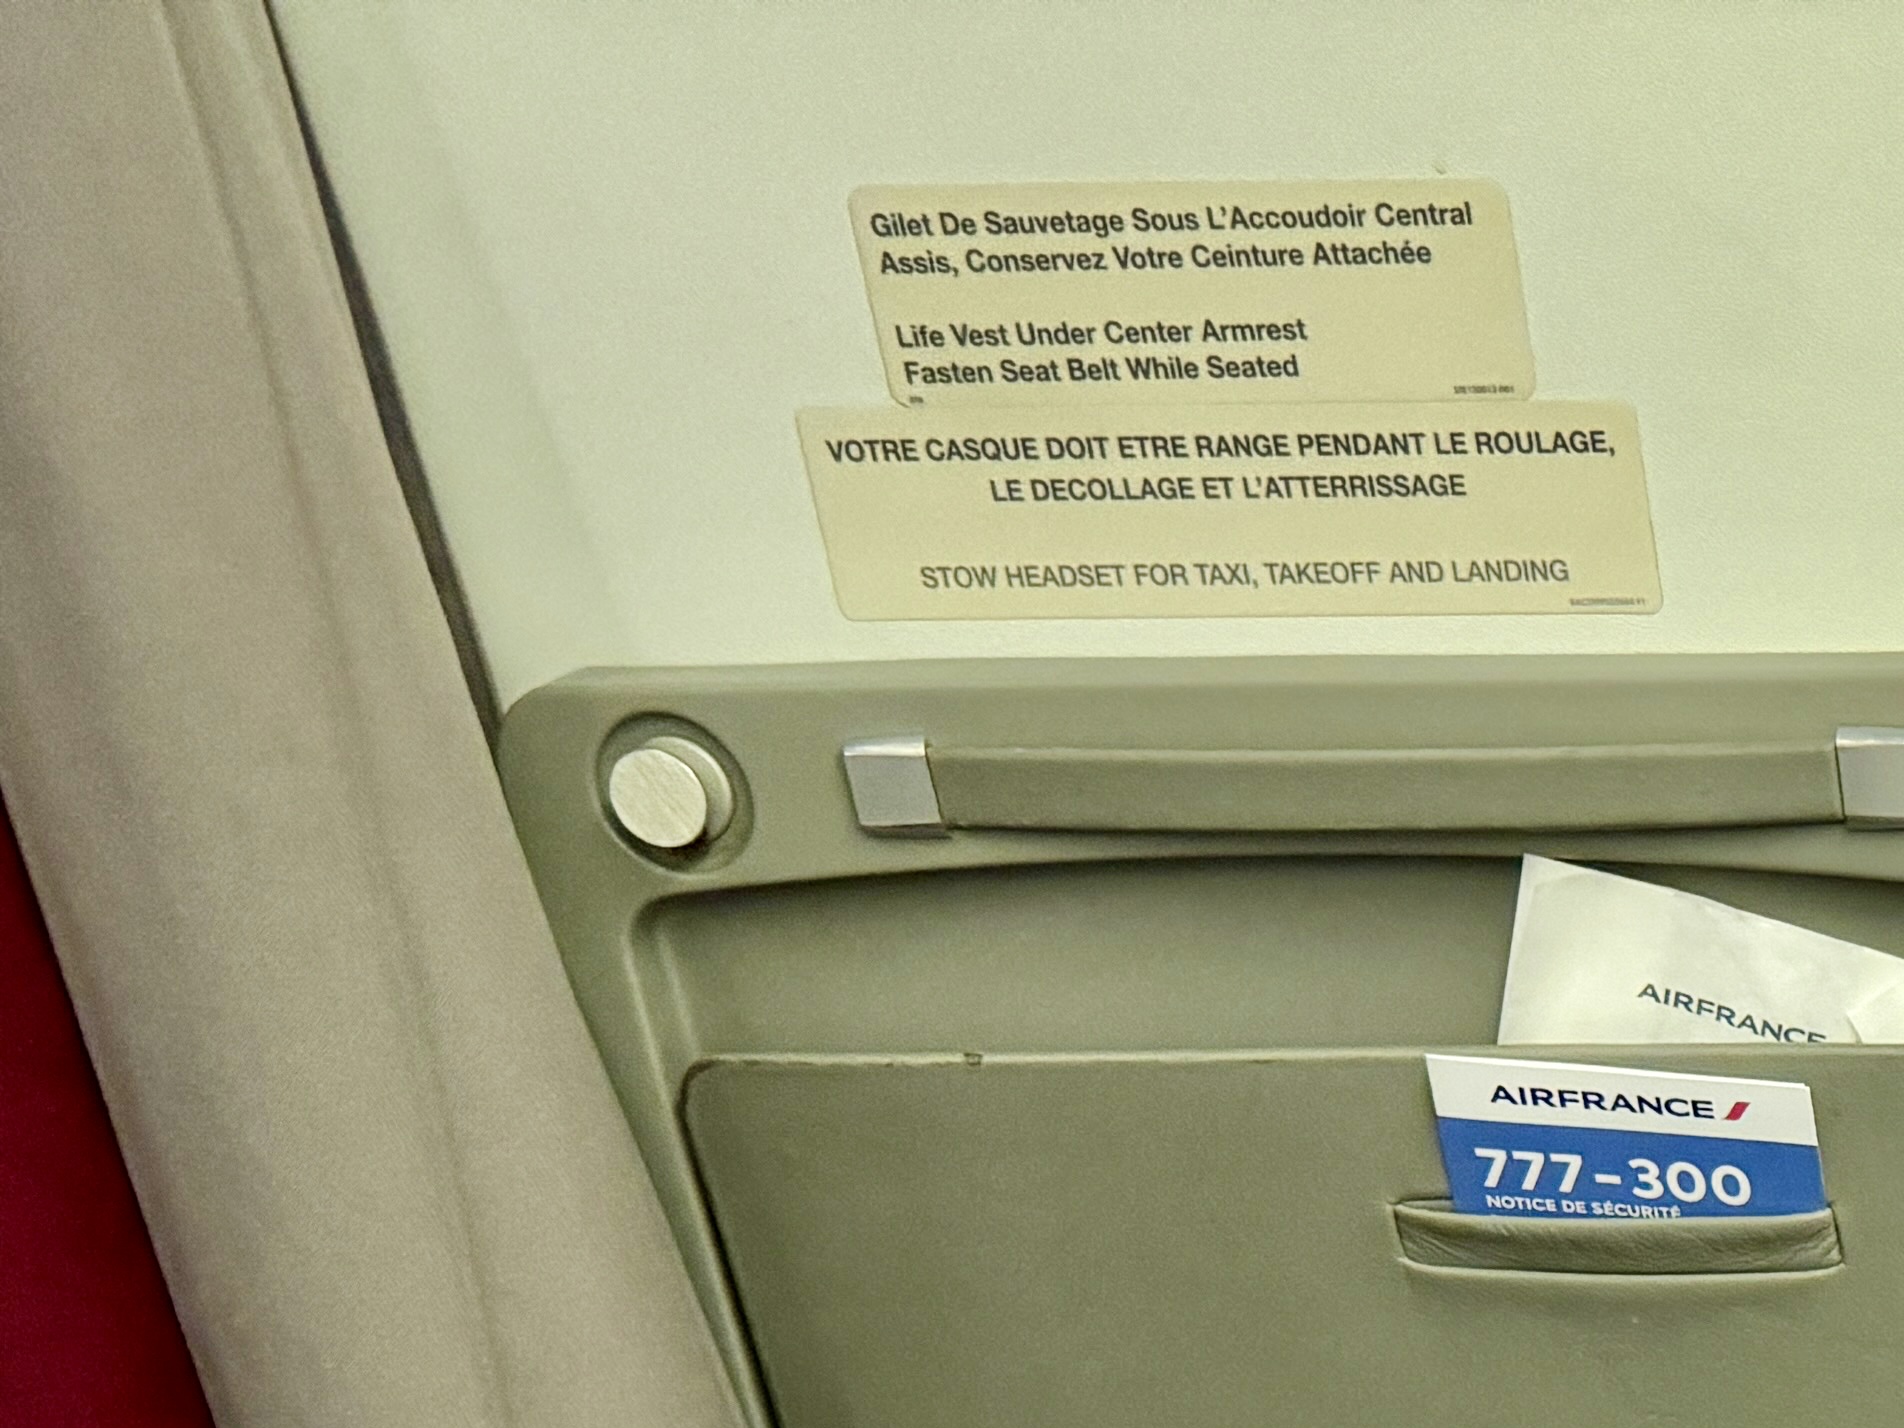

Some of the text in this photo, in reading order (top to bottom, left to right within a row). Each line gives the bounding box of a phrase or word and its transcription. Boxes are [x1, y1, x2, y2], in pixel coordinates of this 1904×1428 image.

[869, 200, 1473, 239] Gilet De Sauvetage Sous L'Accoudoir Central
[880, 239, 1432, 278] Assis, Conservez Votre Ceinture Attachée
[894, 318, 1308, 349] Life Vest Under Center Armrest
[903, 353, 1300, 386] Fasten Seat Belt While Seated
[824, 430, 1616, 463] VOTRE CASQUE DOIT ETRE RANGE PENDANT LE ROULAGE,
[989, 473, 1468, 503] LE DECOLLAGE ET L'ATTERRISSAGE
[919, 559, 1570, 590] STOW HEADSET FOR TAXI, TAKEOFF AND LANDING
[1636, 982, 1828, 1043] AIRFRANCE
[1490, 1084, 1715, 1120] AIRFRANCE
[1485, 1194, 1682, 1218] NOTICE DE SÉCURITÉ
